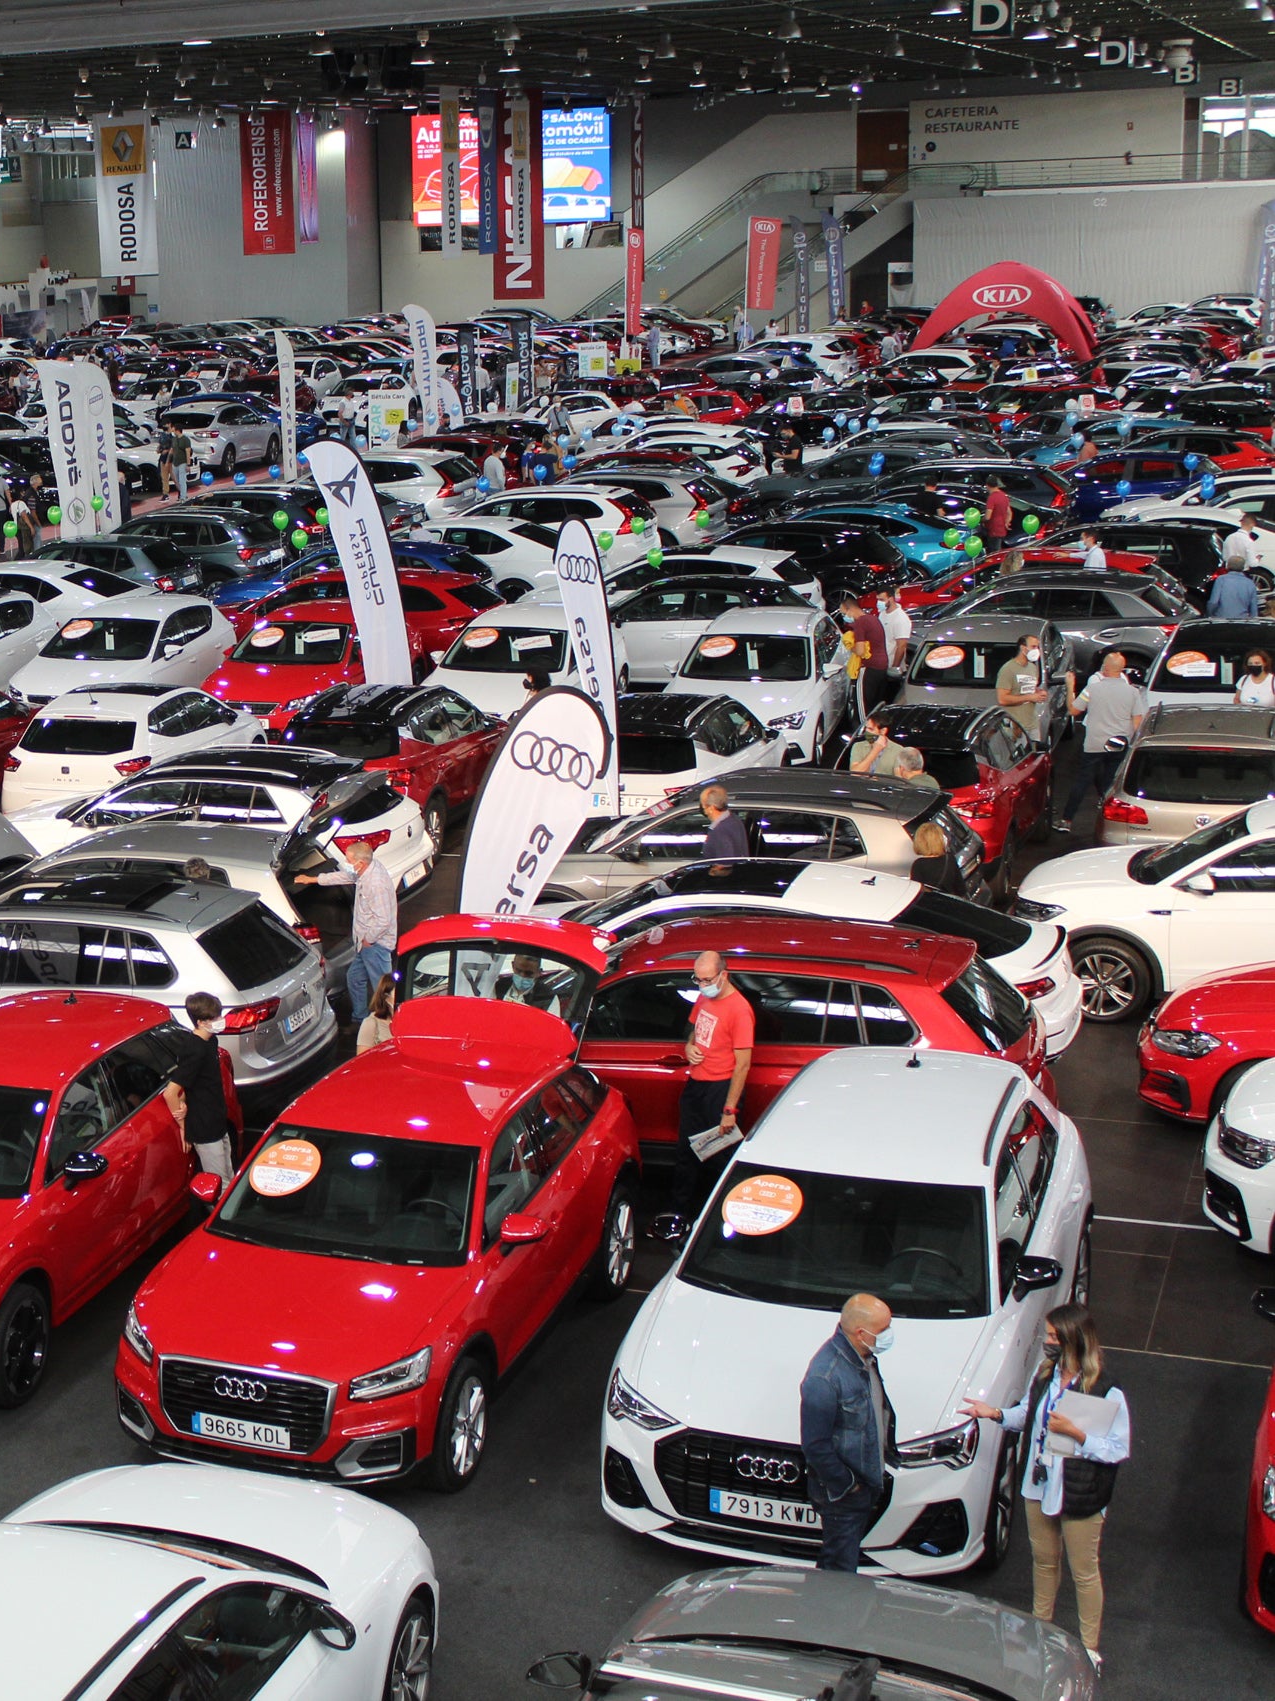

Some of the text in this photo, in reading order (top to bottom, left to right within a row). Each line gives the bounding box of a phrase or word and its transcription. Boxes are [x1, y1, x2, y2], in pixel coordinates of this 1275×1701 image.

[972, 0, 1009, 32] D
[1100, 41, 1127, 66] D
[1175, 62, 1196, 84] B
[1220, 78, 1239, 96] B
[550, 111, 592, 123] SALÓN
[924, 105, 999, 119] CAFETERIA
[543, 121, 604, 138] omóvil
[924, 119, 1020, 134] RESTAURANTE
[176, 133, 190, 148] A
[567, 135, 604, 144] OCASIÓN
[106, 163, 143, 174] RENAULT
[250, 115, 269, 232] ROFERORENSE
[273, 128, 283, 217] www.roferorense.com
[633, 97, 642, 230] SSAN
[447, 161, 456, 244] RODOSA
[484, 162, 492, 243] RODOSA
[517, 167, 525, 245] RODOSA
[117, 181, 138, 263] RODOSA
[757, 221, 772, 232] KIA
[797, 249, 807, 333] Cibrauto
[829, 244, 841, 316] Cibraut
[982, 288, 1023, 303] KIA
[495, 822, 554, 918] ersa
[279, 1143, 312, 1155] Apersa
[752, 1178, 792, 1191] Apersa
[204, 1416, 285, 1445] 9665 KDL
[726, 1496, 817, 1524] 7913 KWD
